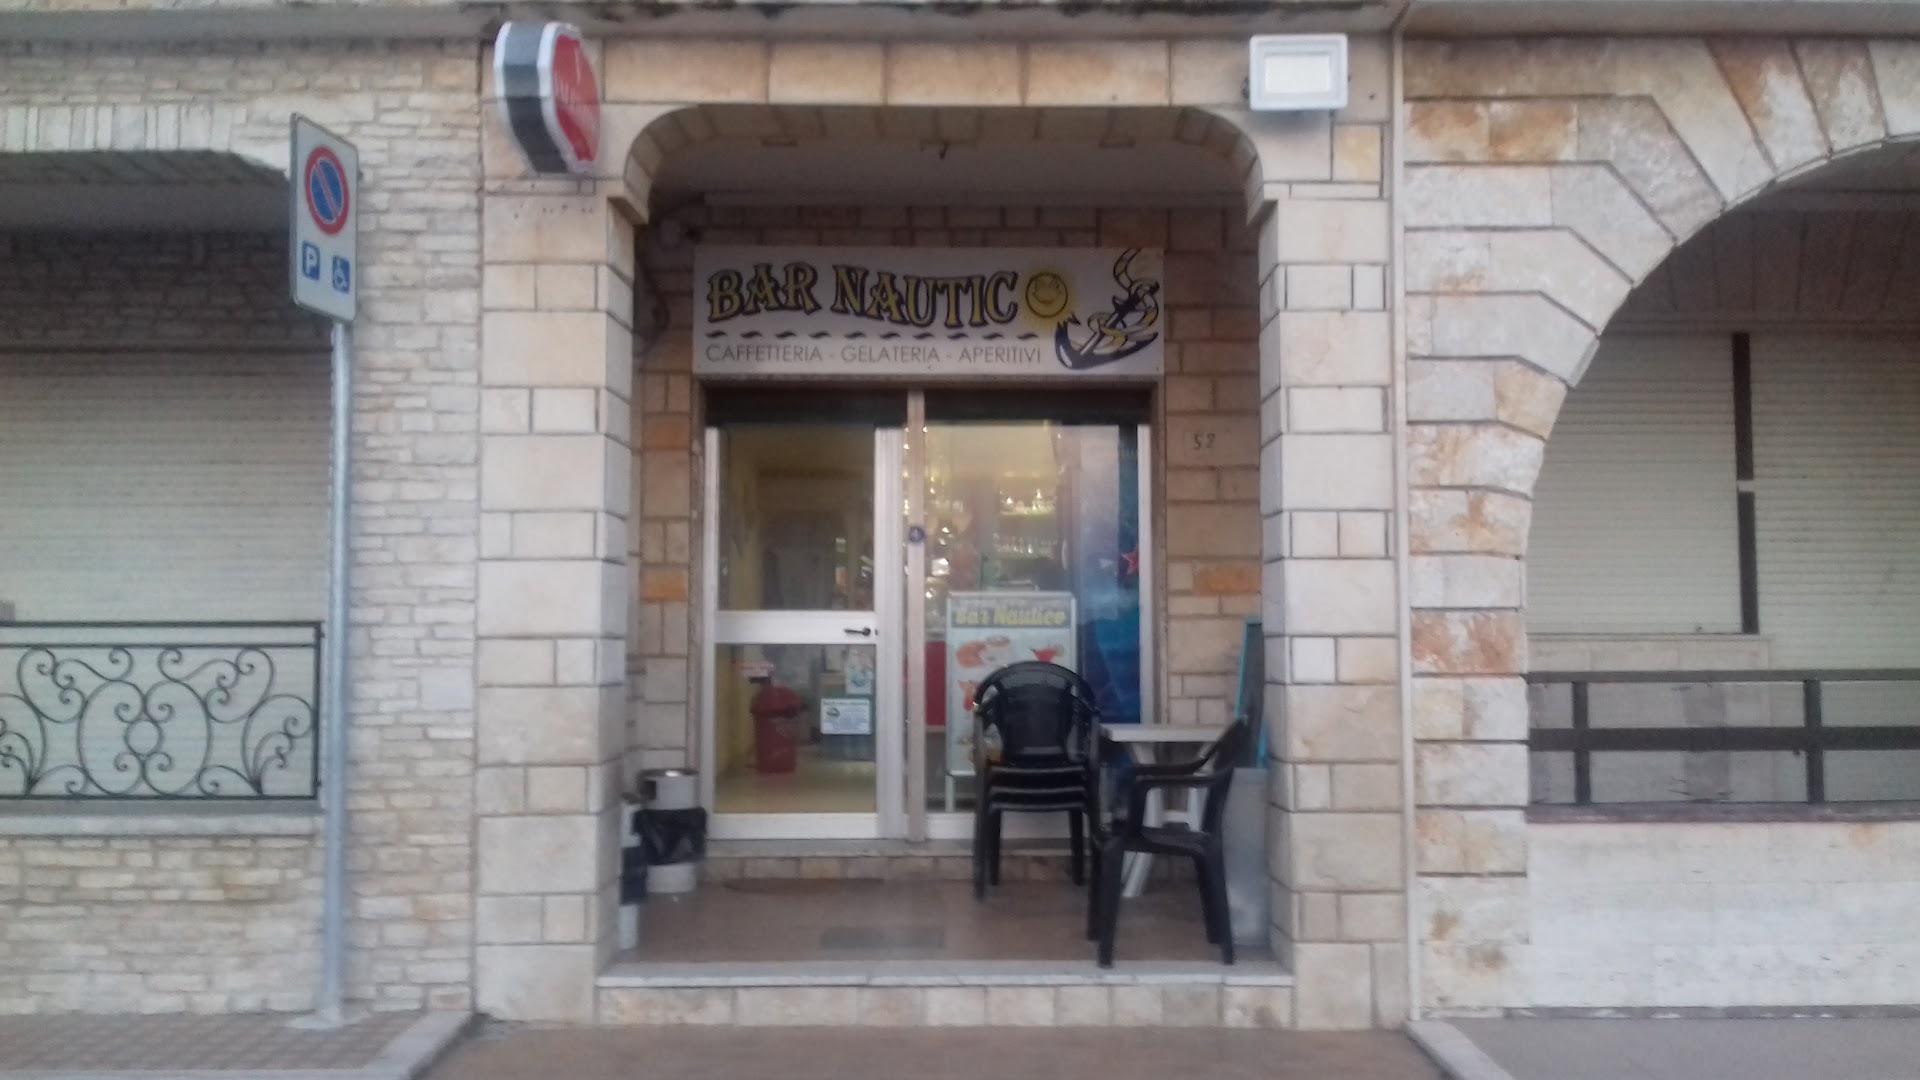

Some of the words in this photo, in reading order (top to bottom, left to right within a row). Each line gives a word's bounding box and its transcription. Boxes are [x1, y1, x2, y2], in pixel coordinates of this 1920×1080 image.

[706, 261, 822, 324] BAR
[705, 343, 824, 363] CAFFETTERIA
[840, 344, 941, 363] GELATERIA
[957, 345, 1042, 364] APERITIVI
